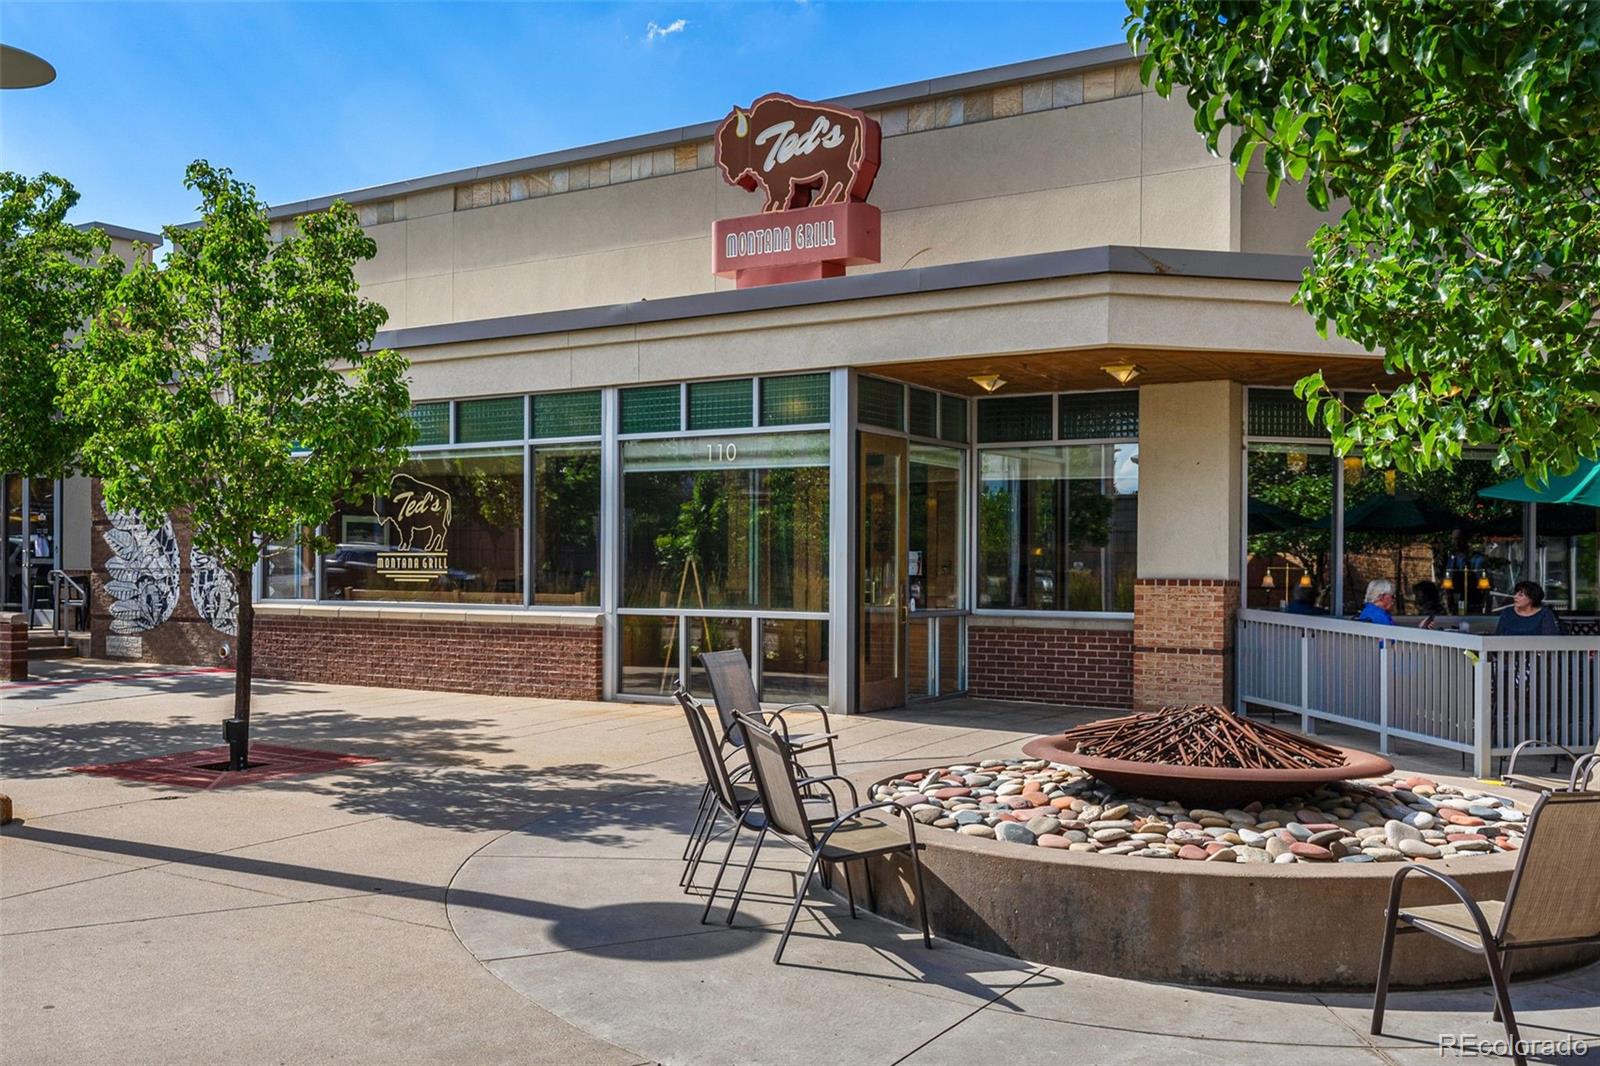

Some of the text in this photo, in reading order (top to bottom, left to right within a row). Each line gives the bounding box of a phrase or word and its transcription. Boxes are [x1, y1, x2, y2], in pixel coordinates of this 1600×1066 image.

[755, 116, 845, 172] Ted's
[726, 220, 836, 258] MONTANA GRILL
[707, 443, 737, 462] 110
[393, 491, 442, 521] Ted's
[377, 557, 448, 569] MONTANA GRILL
